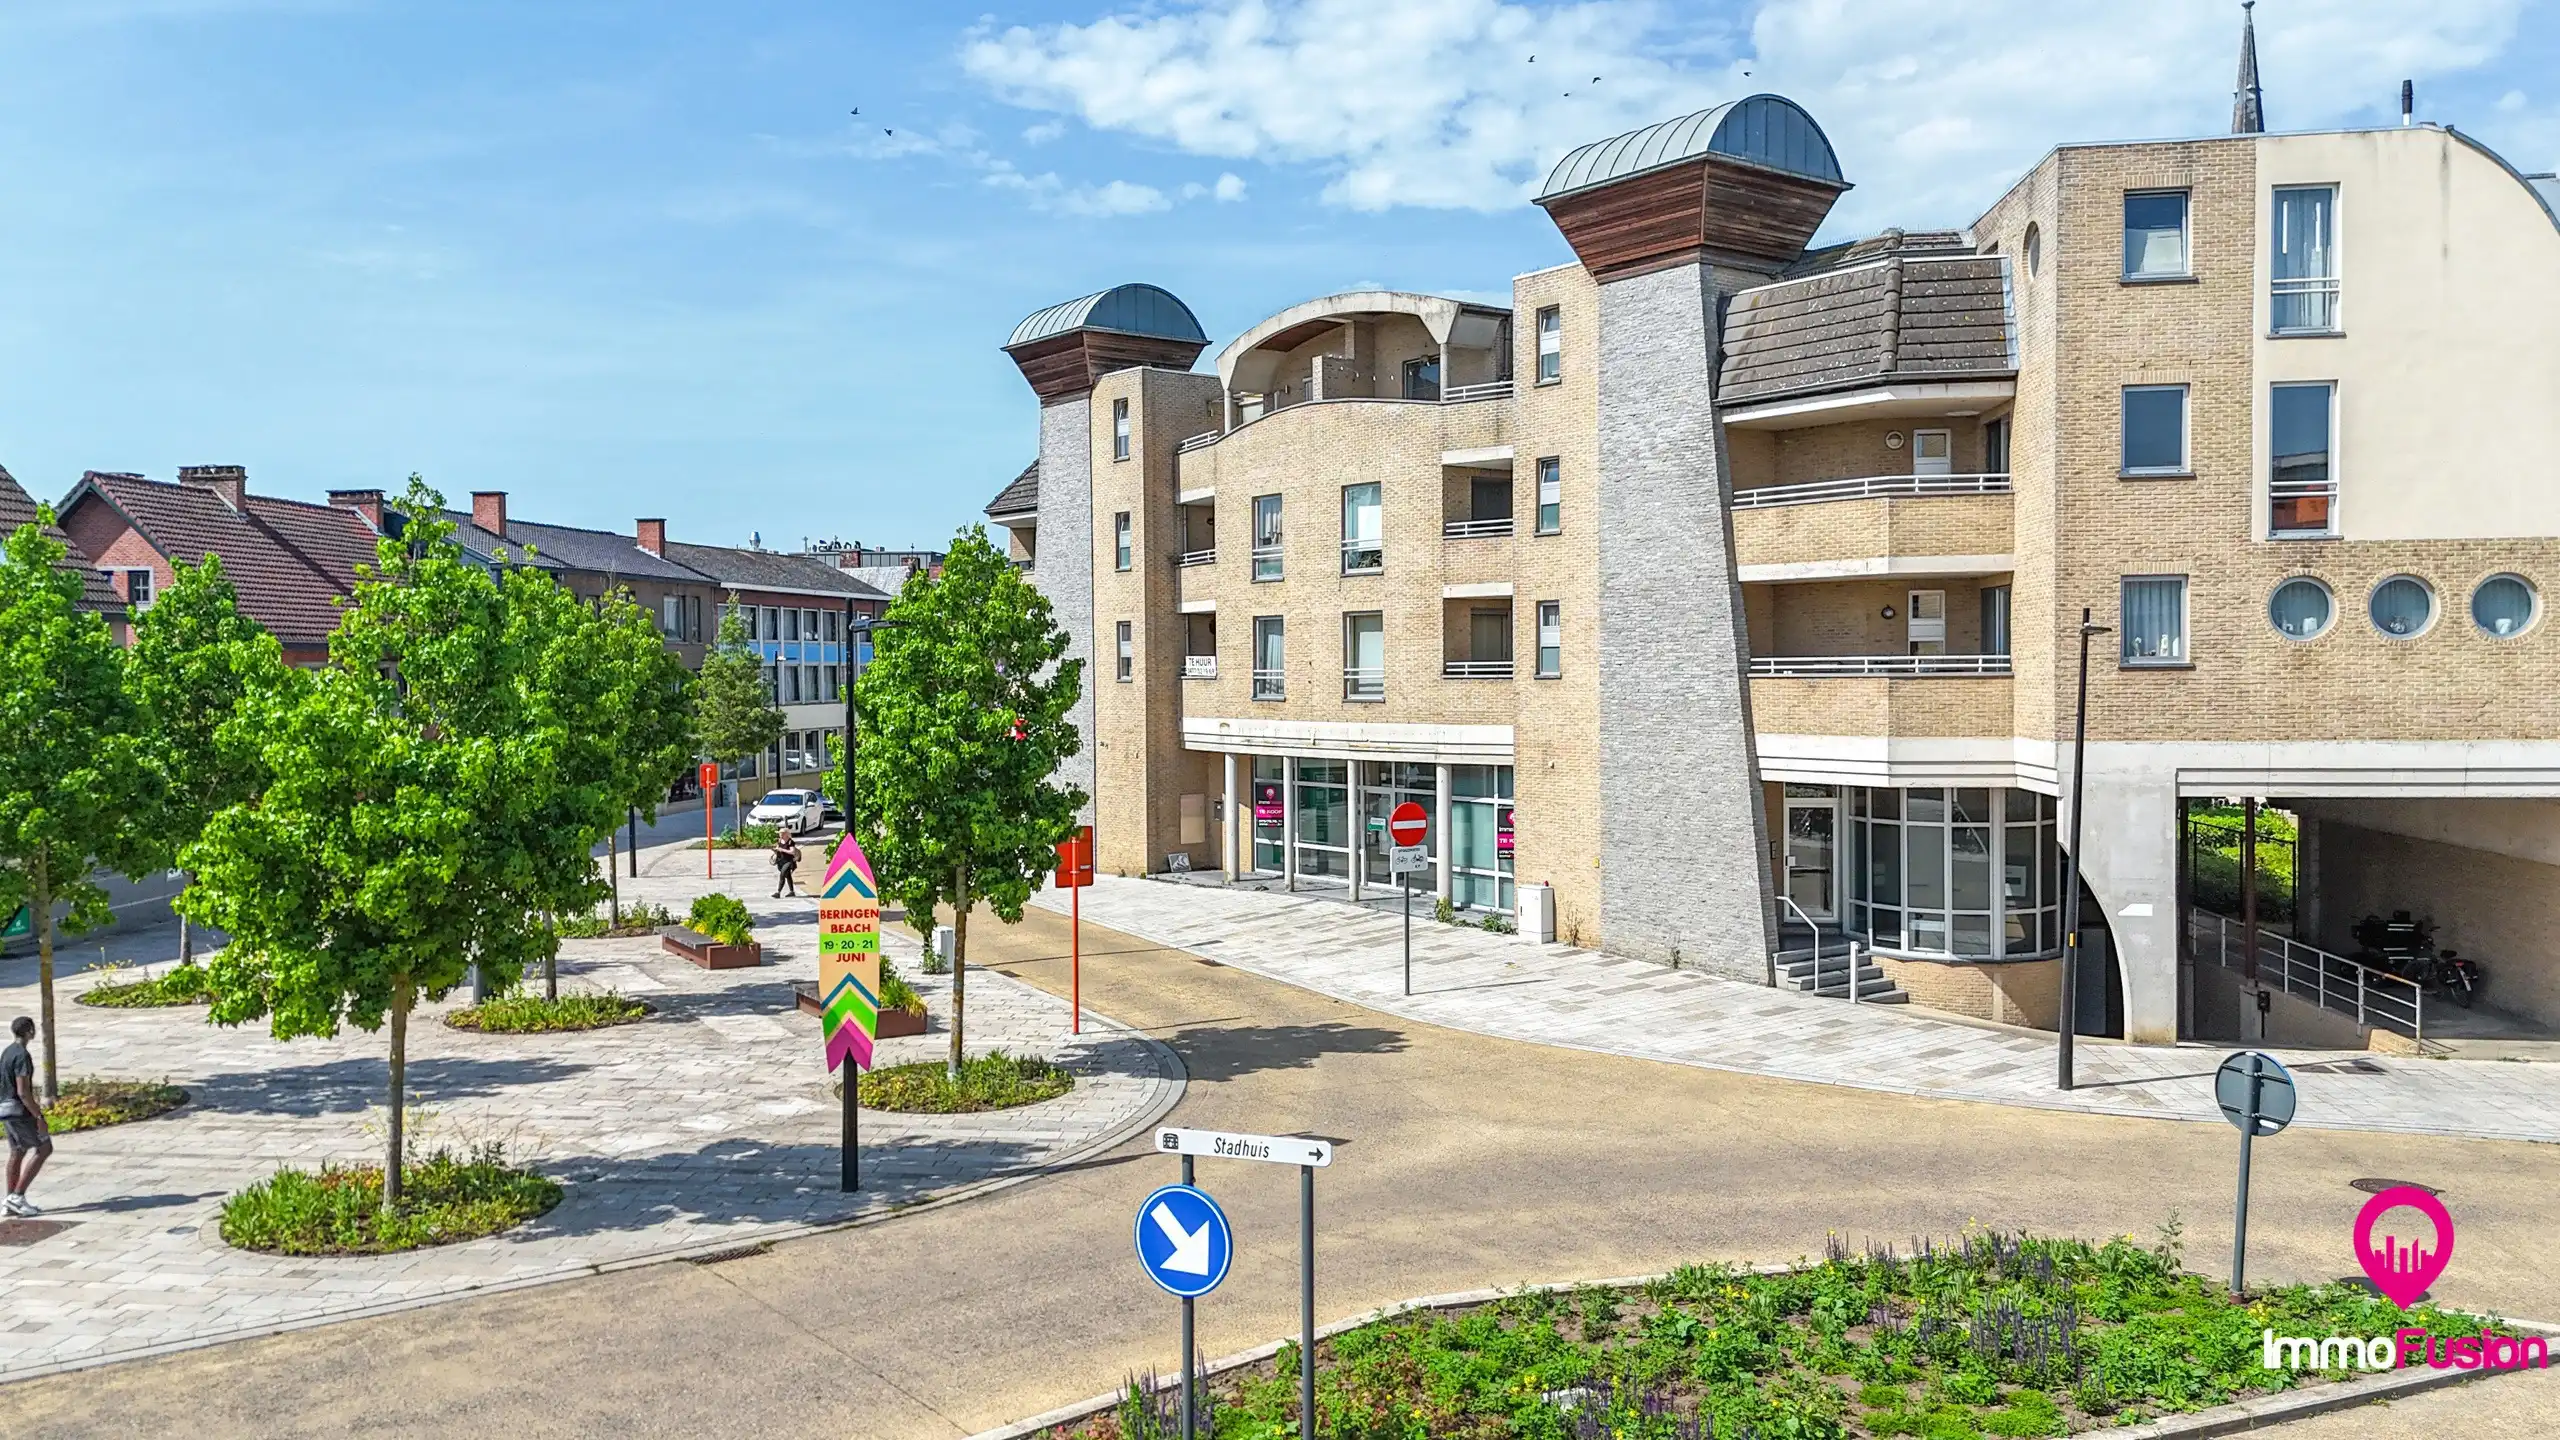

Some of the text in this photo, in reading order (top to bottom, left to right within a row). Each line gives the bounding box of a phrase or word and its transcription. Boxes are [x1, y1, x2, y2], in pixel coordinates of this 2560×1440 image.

[1188, 658, 1212, 667] TE HUUR
[820, 908, 880, 920] BERINGEN
[830, 923, 871, 934] BEACH
[823, 939, 873, 950] 19 20 21
[836, 952, 866, 963] JUNI
[1213, 1137, 1270, 1159] Stadhuis
